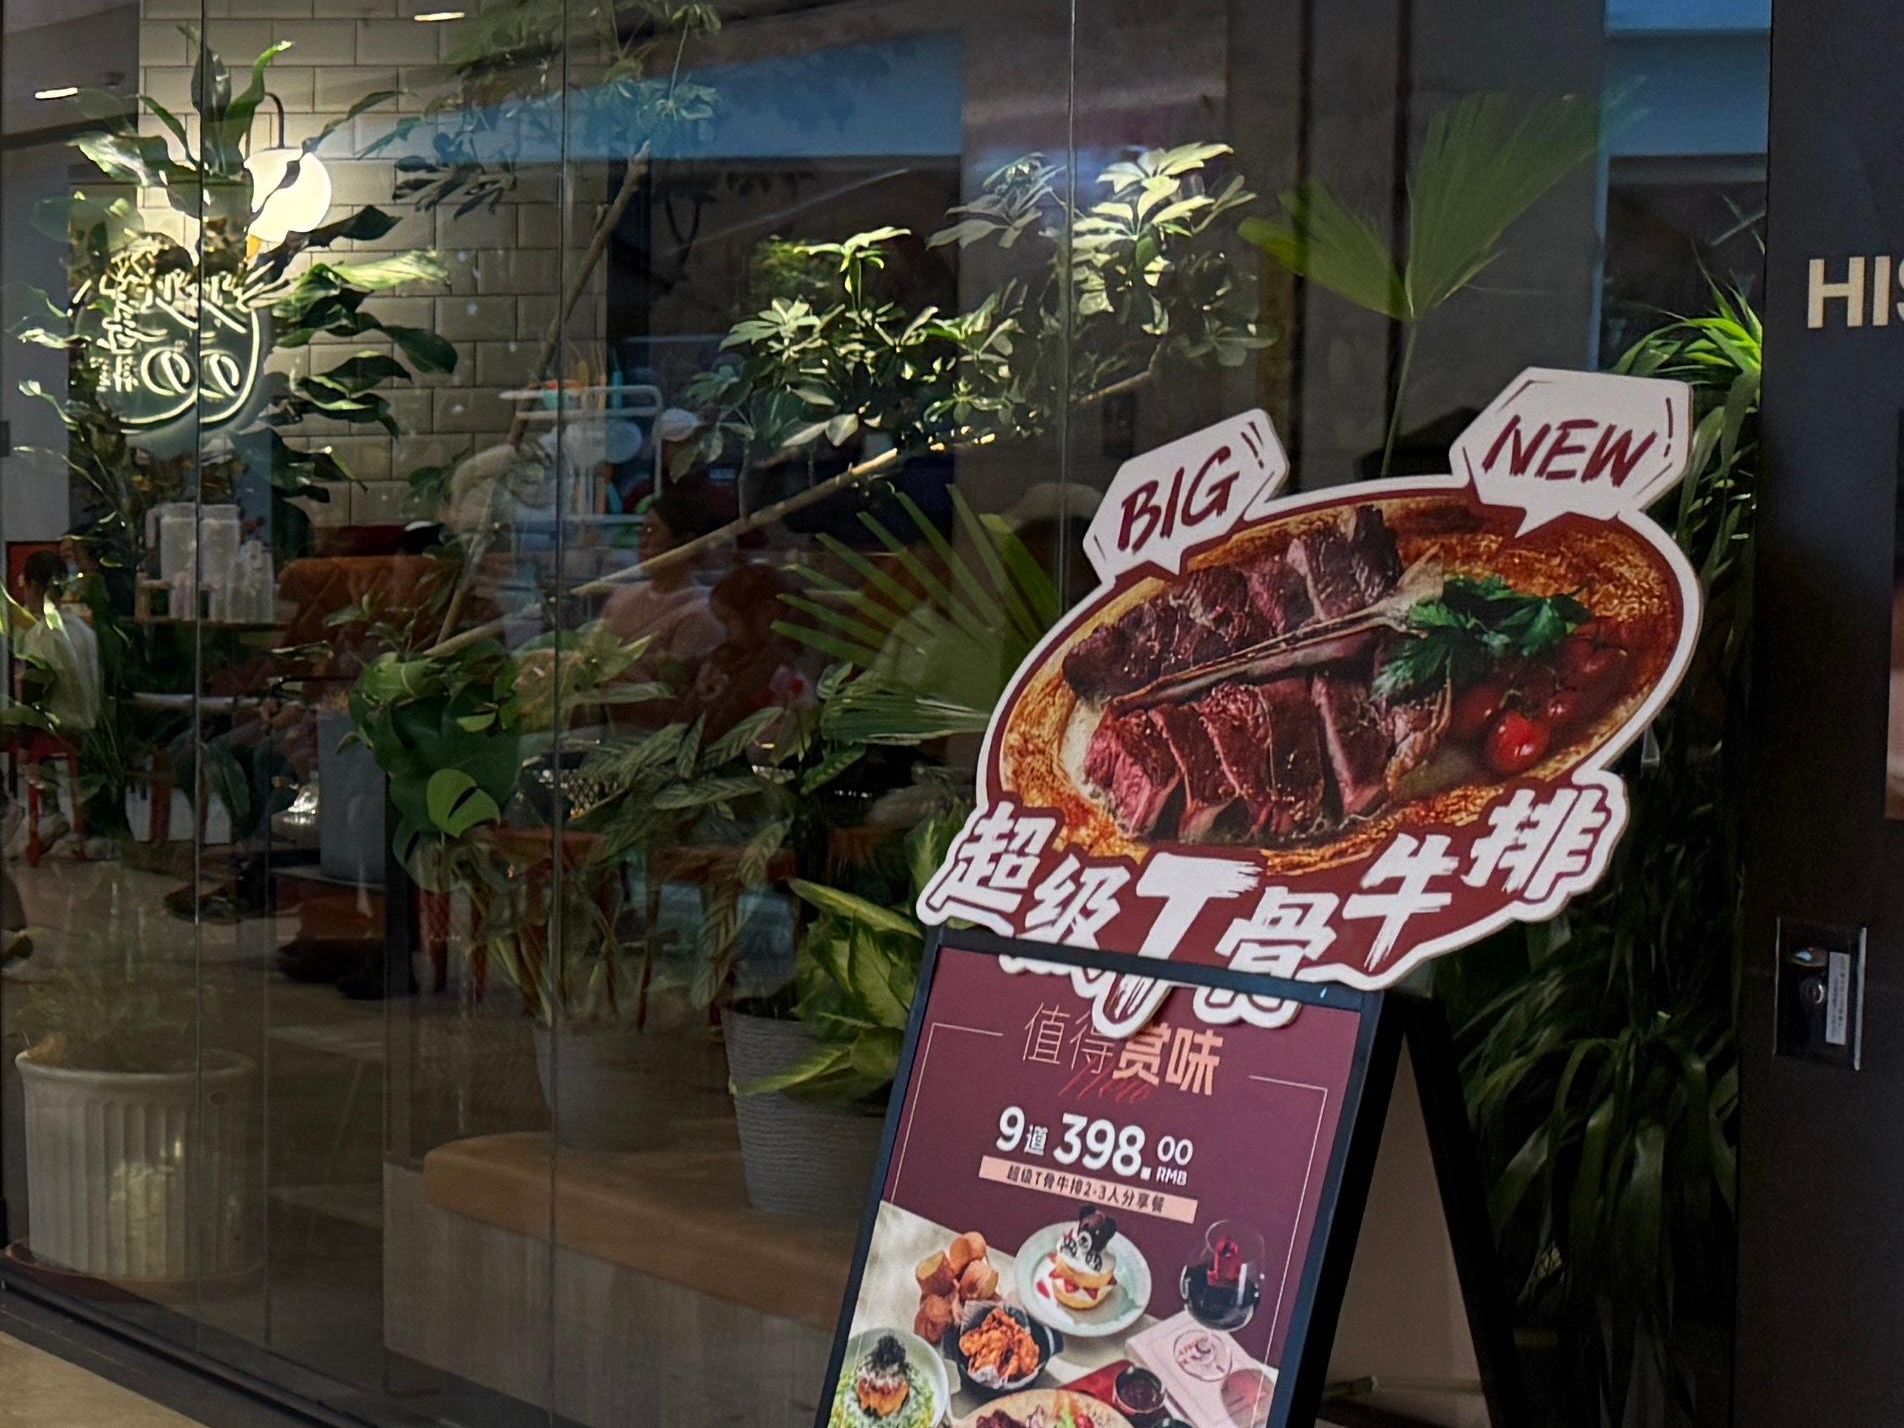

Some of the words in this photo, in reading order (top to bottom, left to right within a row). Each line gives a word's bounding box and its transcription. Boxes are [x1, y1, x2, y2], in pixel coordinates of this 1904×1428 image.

[1807, 255, 1904, 329] HI
[1021, 1002, 1224, 1096] 值得赏味
[1155, 1166, 1189, 1186] RMB
